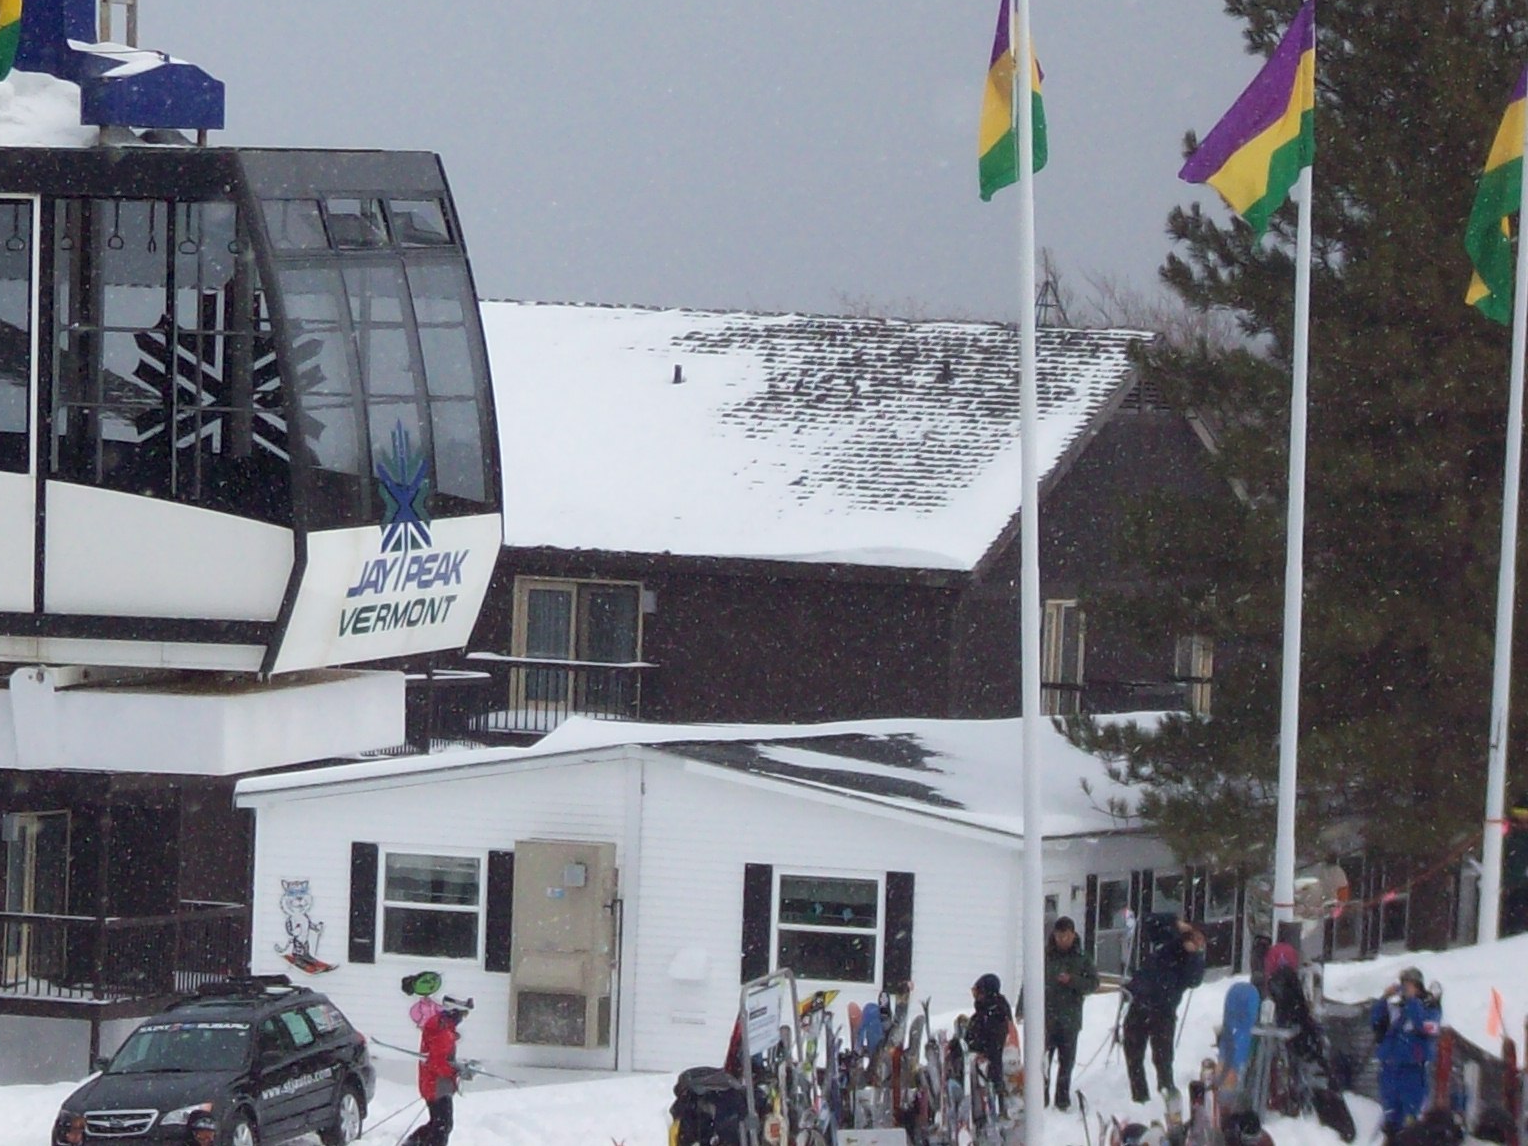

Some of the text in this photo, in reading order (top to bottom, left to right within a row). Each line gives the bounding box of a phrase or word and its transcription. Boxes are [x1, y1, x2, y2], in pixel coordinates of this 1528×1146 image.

[346, 549, 469, 598] JAY PEAK
[338, 595, 457, 637] VERMONT
